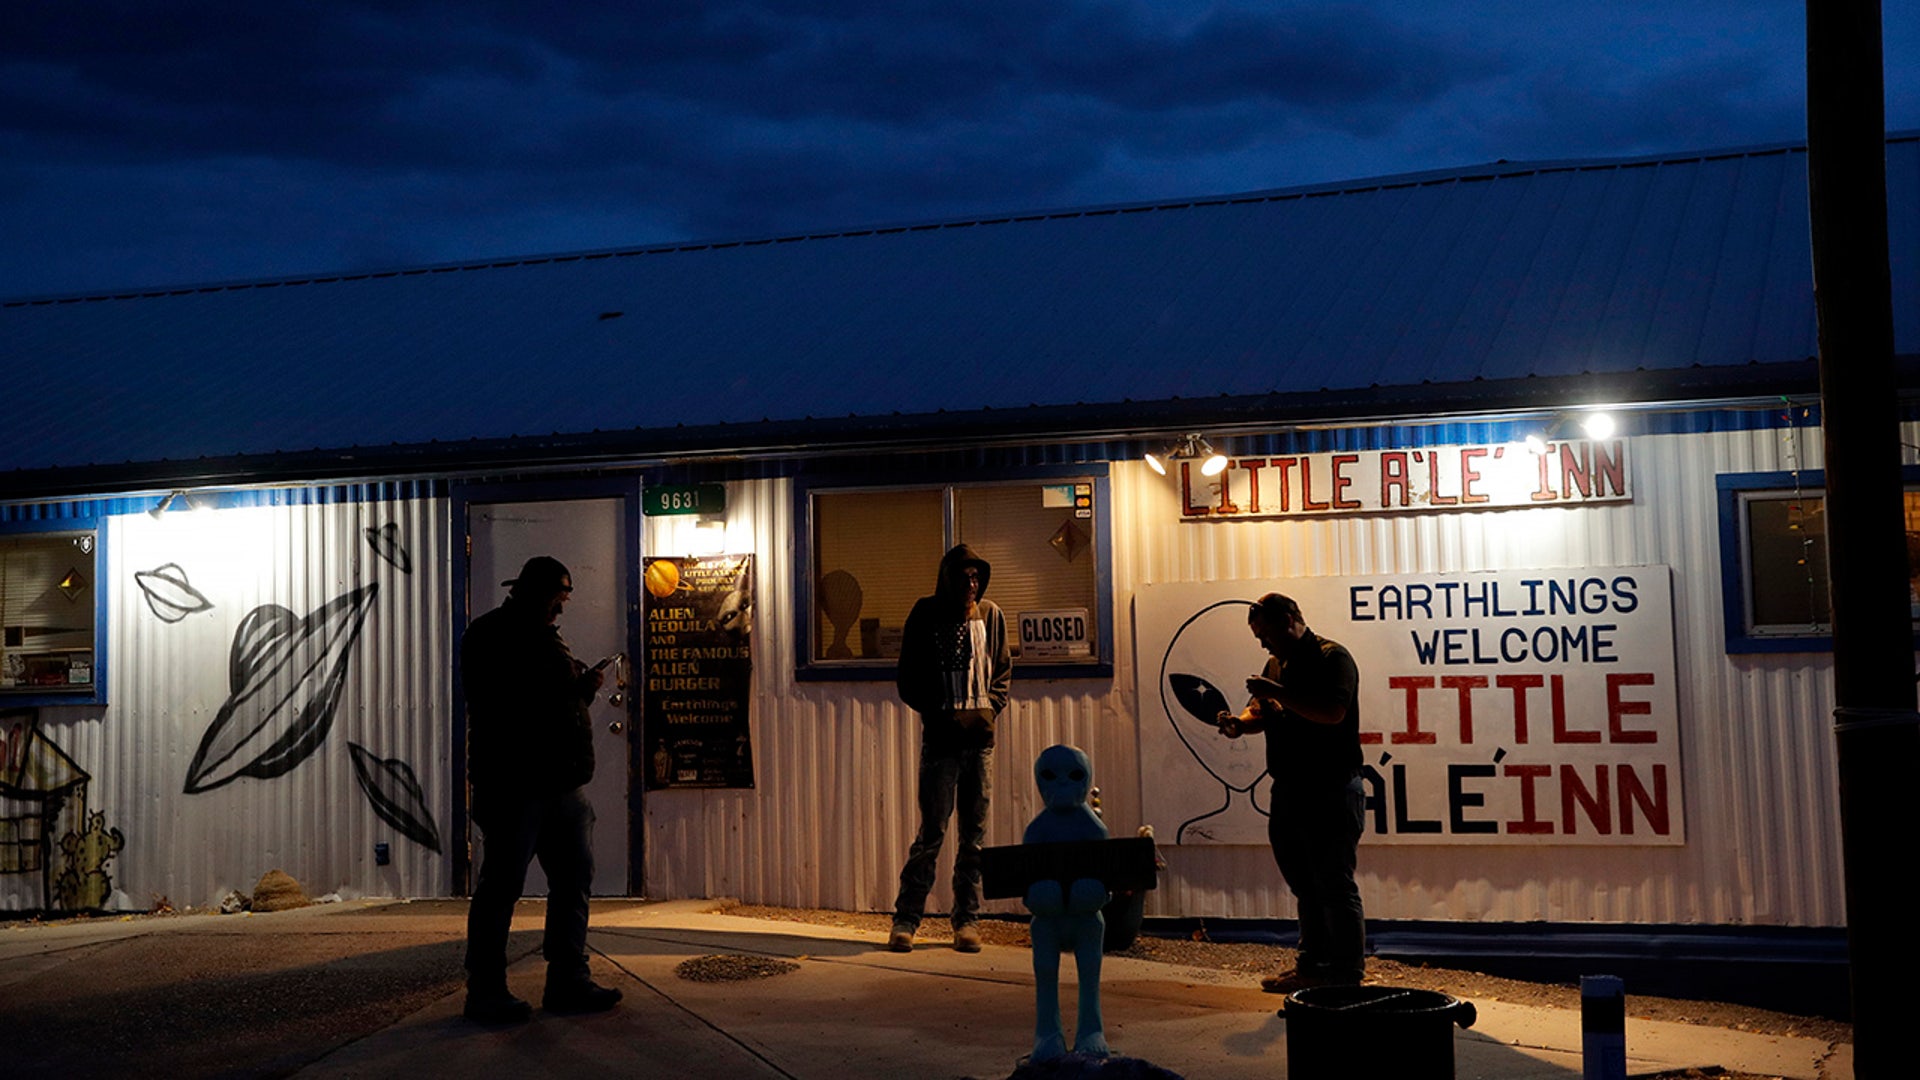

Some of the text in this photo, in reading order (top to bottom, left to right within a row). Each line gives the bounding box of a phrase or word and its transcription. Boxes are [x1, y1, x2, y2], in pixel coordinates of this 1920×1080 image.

[1182, 455, 1361, 516] LITTLE
[1530, 440, 1625, 502] INN
[661, 490, 700, 510] 9631
[1350, 576, 1639, 622] EARTHLINGS
[649, 608, 695, 621] ALIEN
[650, 620, 716, 633] TEQUILA
[1022, 616, 1084, 642] CLOSED
[649, 634, 676, 645] AND
[1411, 624, 1620, 666] WELCOME
[650, 646, 750, 660] THE FAMOUS
[649, 662, 700, 676] ALIEN
[649, 677, 721, 692] BURGER
[1358, 673, 1659, 745] ITTLE
[666, 713, 734, 725] Welcome
